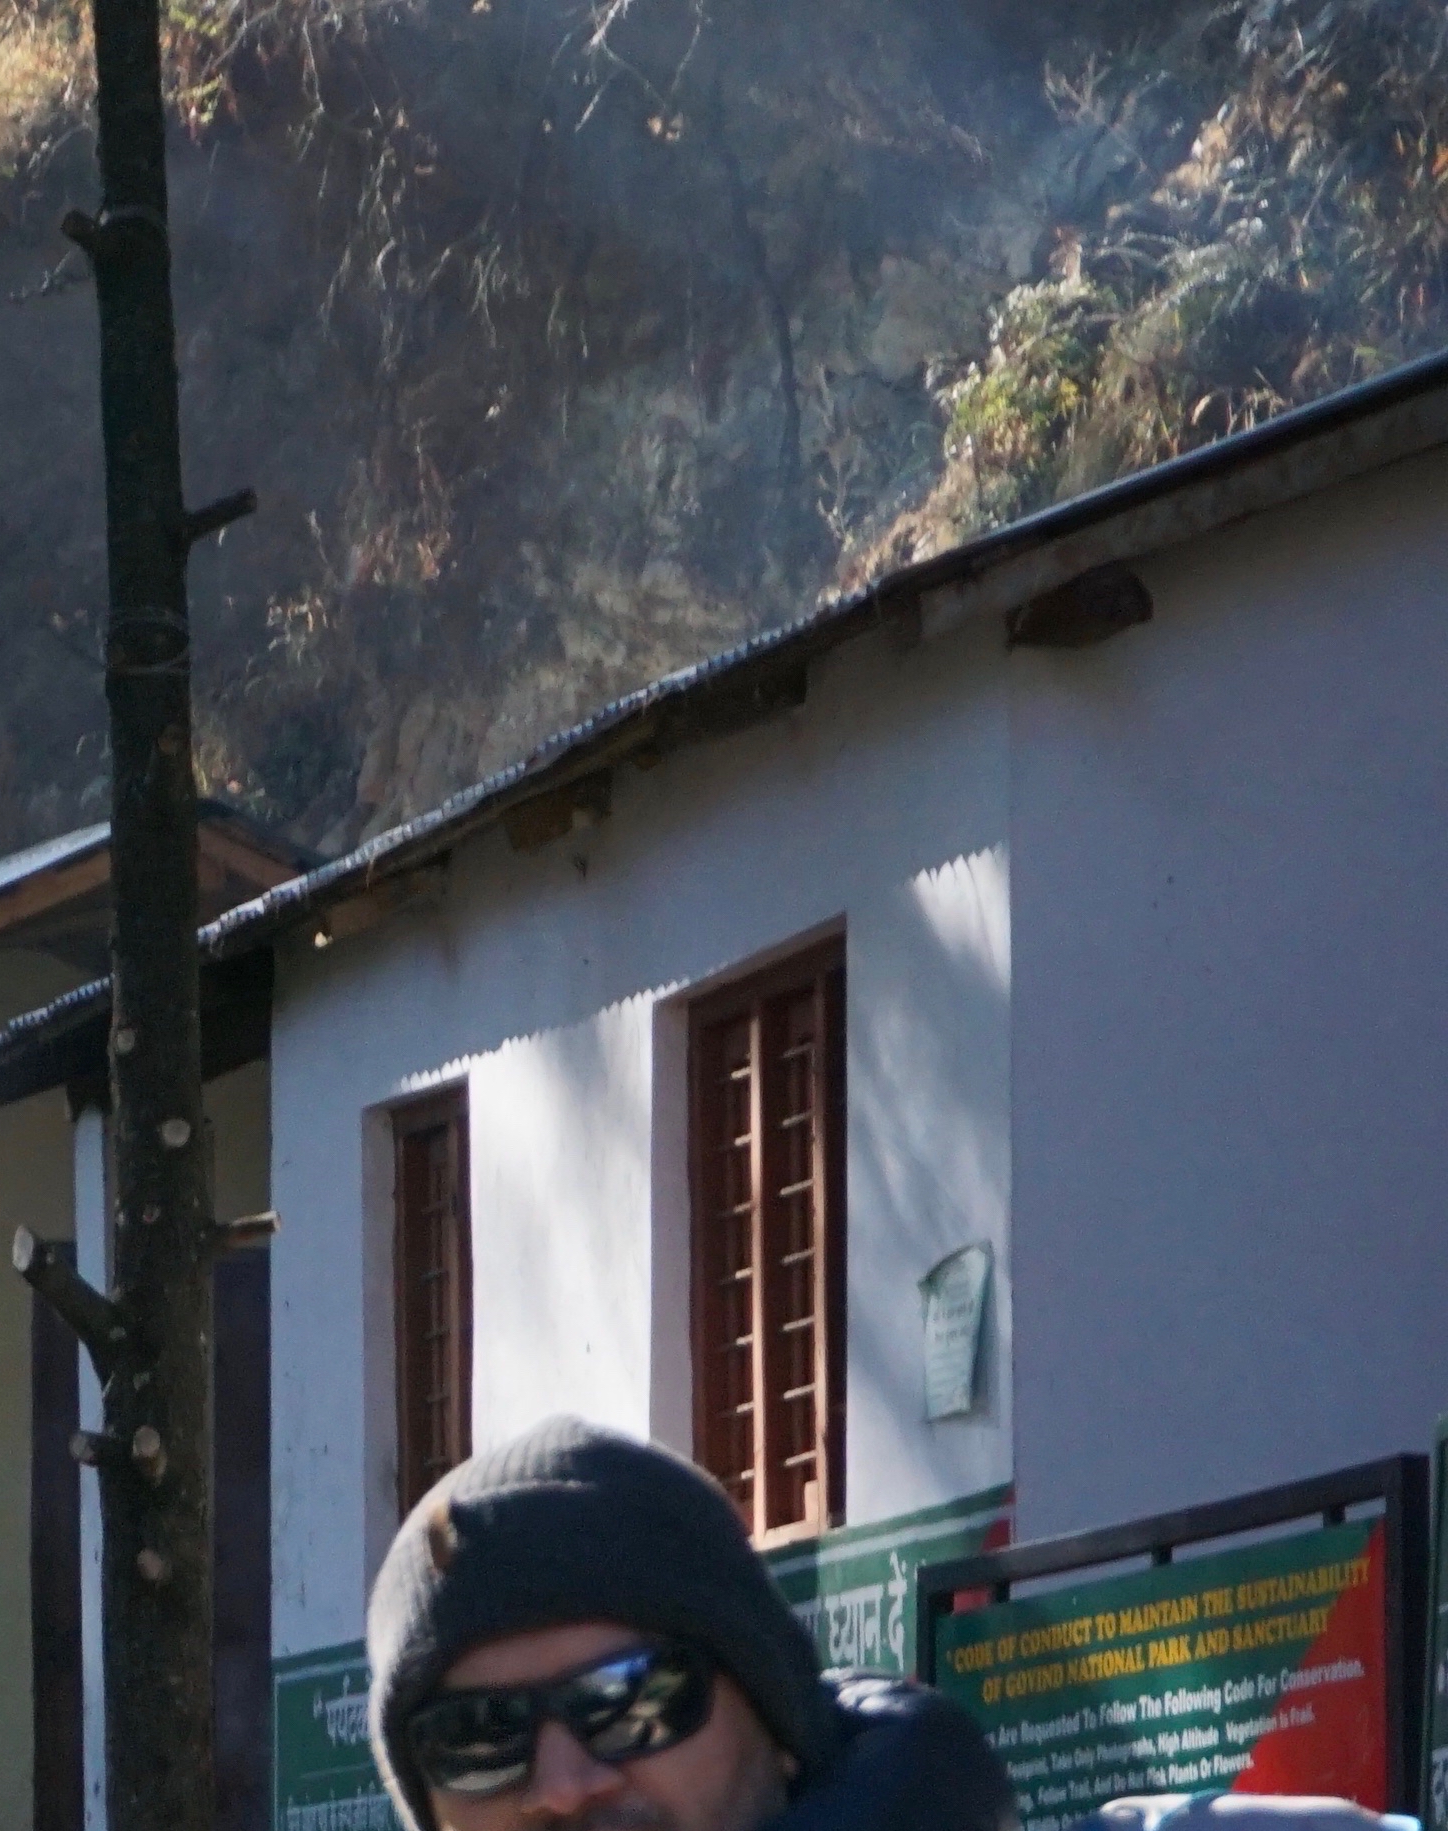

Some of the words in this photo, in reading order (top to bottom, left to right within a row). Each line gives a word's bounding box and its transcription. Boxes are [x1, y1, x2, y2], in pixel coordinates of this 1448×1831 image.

[1019, 1616, 1093, 1659] CONDUCT
[1094, 1612, 1117, 1642] TO
[1119, 1594, 1199, 1637] MAINTAIN
[1201, 1587, 1234, 1618] THE
[1065, 1641, 1146, 1684] NATIONAL
[1148, 1633, 1192, 1668] PARK
[1195, 1627, 1231, 1660] AND
[1139, 1693, 1163, 1720] The
[1163, 1684, 1222, 1716] Following
[1223, 1674, 1255, 1705] Code
[1257, 1672, 1278, 1698] For
